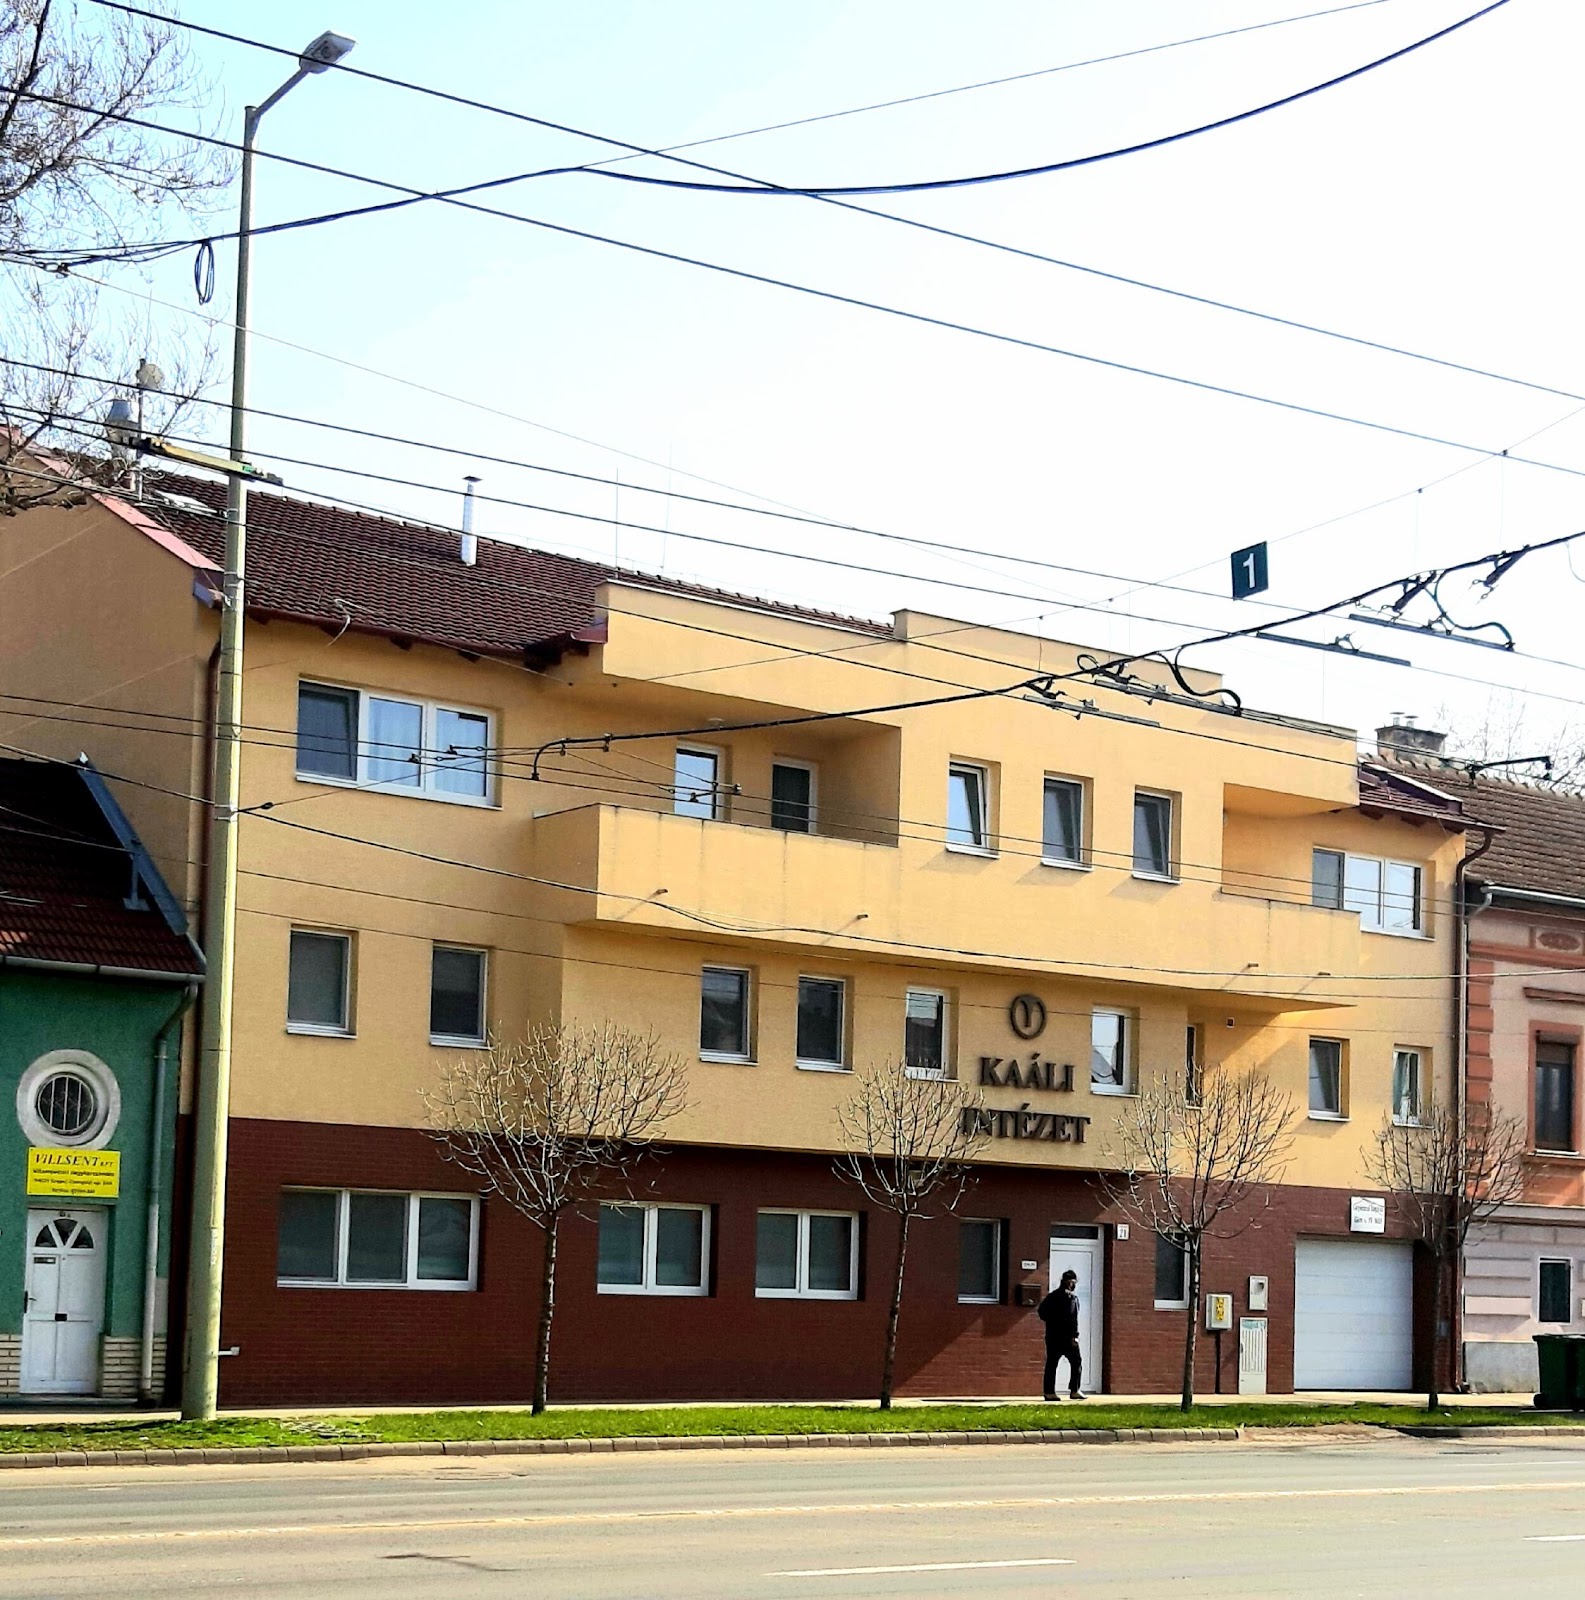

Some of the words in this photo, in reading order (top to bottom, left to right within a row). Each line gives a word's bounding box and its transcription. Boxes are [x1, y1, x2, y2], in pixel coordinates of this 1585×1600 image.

[1243, 552, 1255, 589] 1
[979, 1052, 1075, 1092] KAÁLI
[960, 1102, 1091, 1144] INTÉZET
